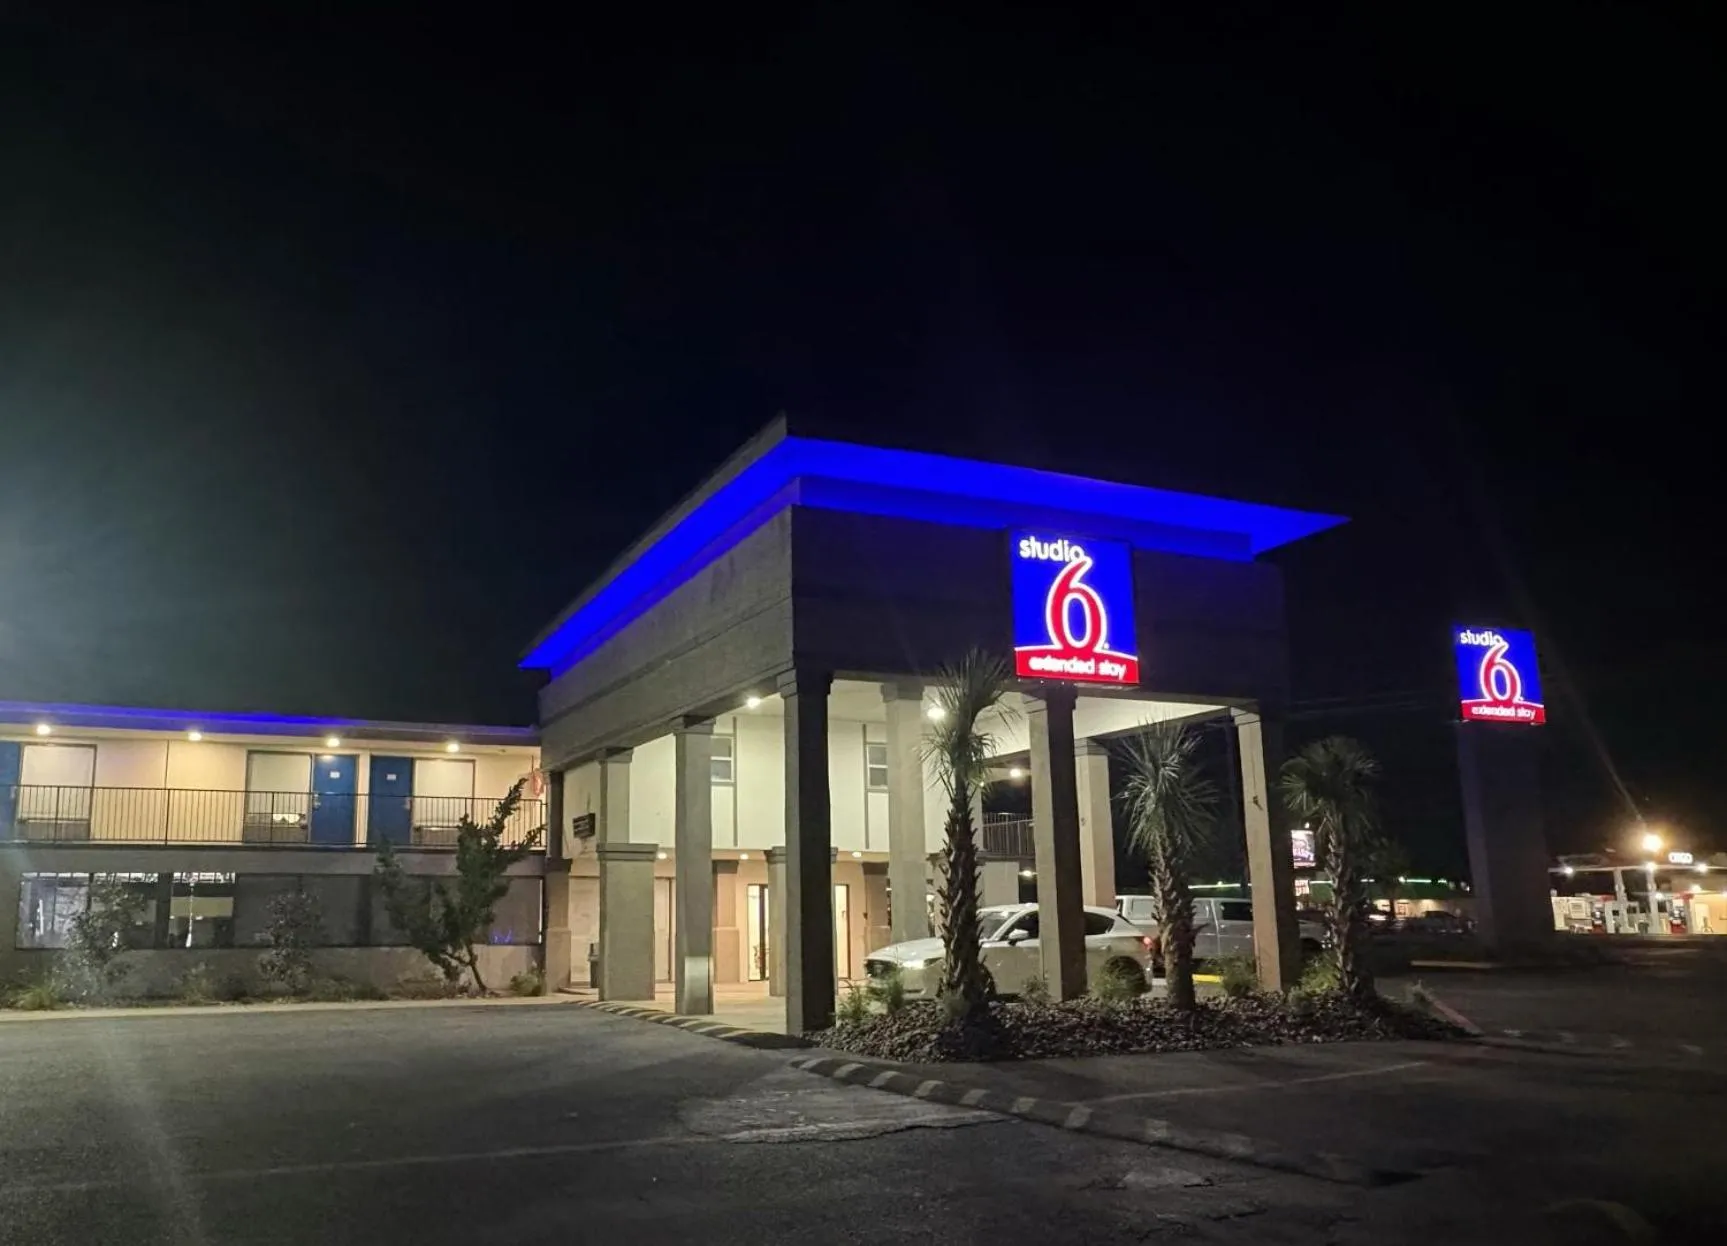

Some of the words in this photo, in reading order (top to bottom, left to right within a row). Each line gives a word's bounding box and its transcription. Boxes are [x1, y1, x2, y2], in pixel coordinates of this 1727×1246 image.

[1019, 536, 1084, 562] studio
[1045, 555, 1108, 648] 6
[1460, 630, 1503, 646] studio
[1098, 659, 1127, 681] stay
[1479, 641, 1522, 701] 6
